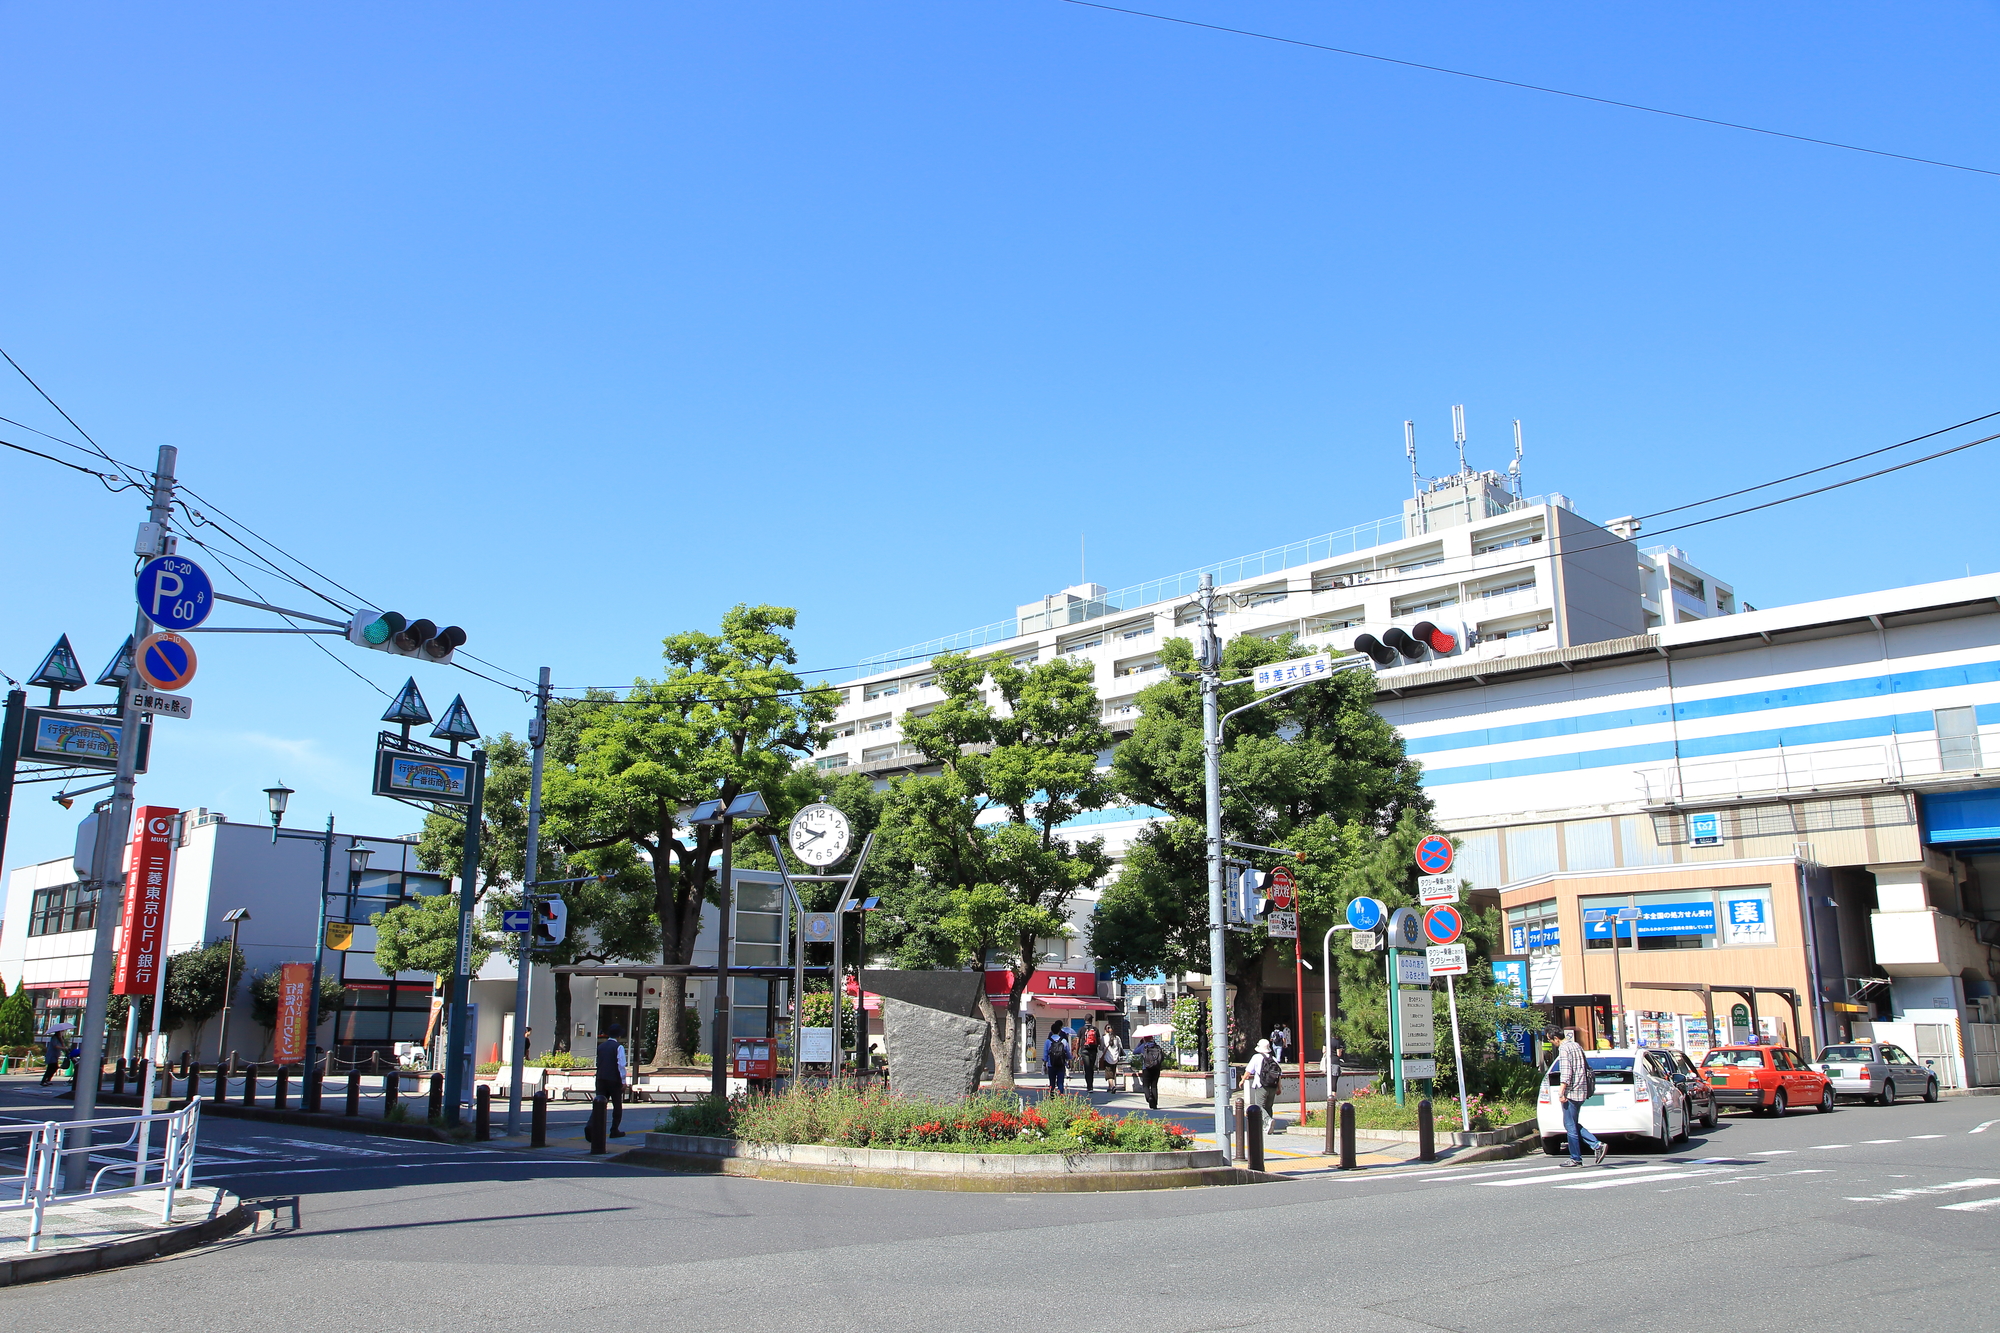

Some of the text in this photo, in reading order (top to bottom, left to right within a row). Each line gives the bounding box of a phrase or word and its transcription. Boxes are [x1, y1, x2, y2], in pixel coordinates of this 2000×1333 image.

[163, 559, 192, 575] 10-20
[152, 569, 184, 615] P
[172, 591, 204, 621] 60 分
[157, 633, 181, 644] 20-10
[1258, 659, 1326, 684] 時差式信号
[133, 694, 187, 714] 白線内を除く
[47, 723, 102, 739] 行徳駅南口
[65, 738, 119, 754] 一番街商店
[399, 763, 440, 777] 行徳駅南口
[806, 813, 814, 821] 11
[816, 810, 825, 818] 12
[799, 821, 808, 830] 10
[835, 820, 841, 828] 2
[796, 831, 802, 840] 9
[838, 830, 844, 839] 3
[807, 849, 813, 857] 7
[816, 852, 822, 860] 6
[826, 849, 832, 857] 5
[1272, 884, 1290, 898] 消火栓
[1640, 910, 1712, 920] 本全国の処方せん受付
[1734, 902, 1759, 923] 薬
[136, 857, 164, 983] 三菱東京UFJ銀行
[1514, 929, 1523, 948] 薬
[1048, 976, 1076, 990] 不二家
